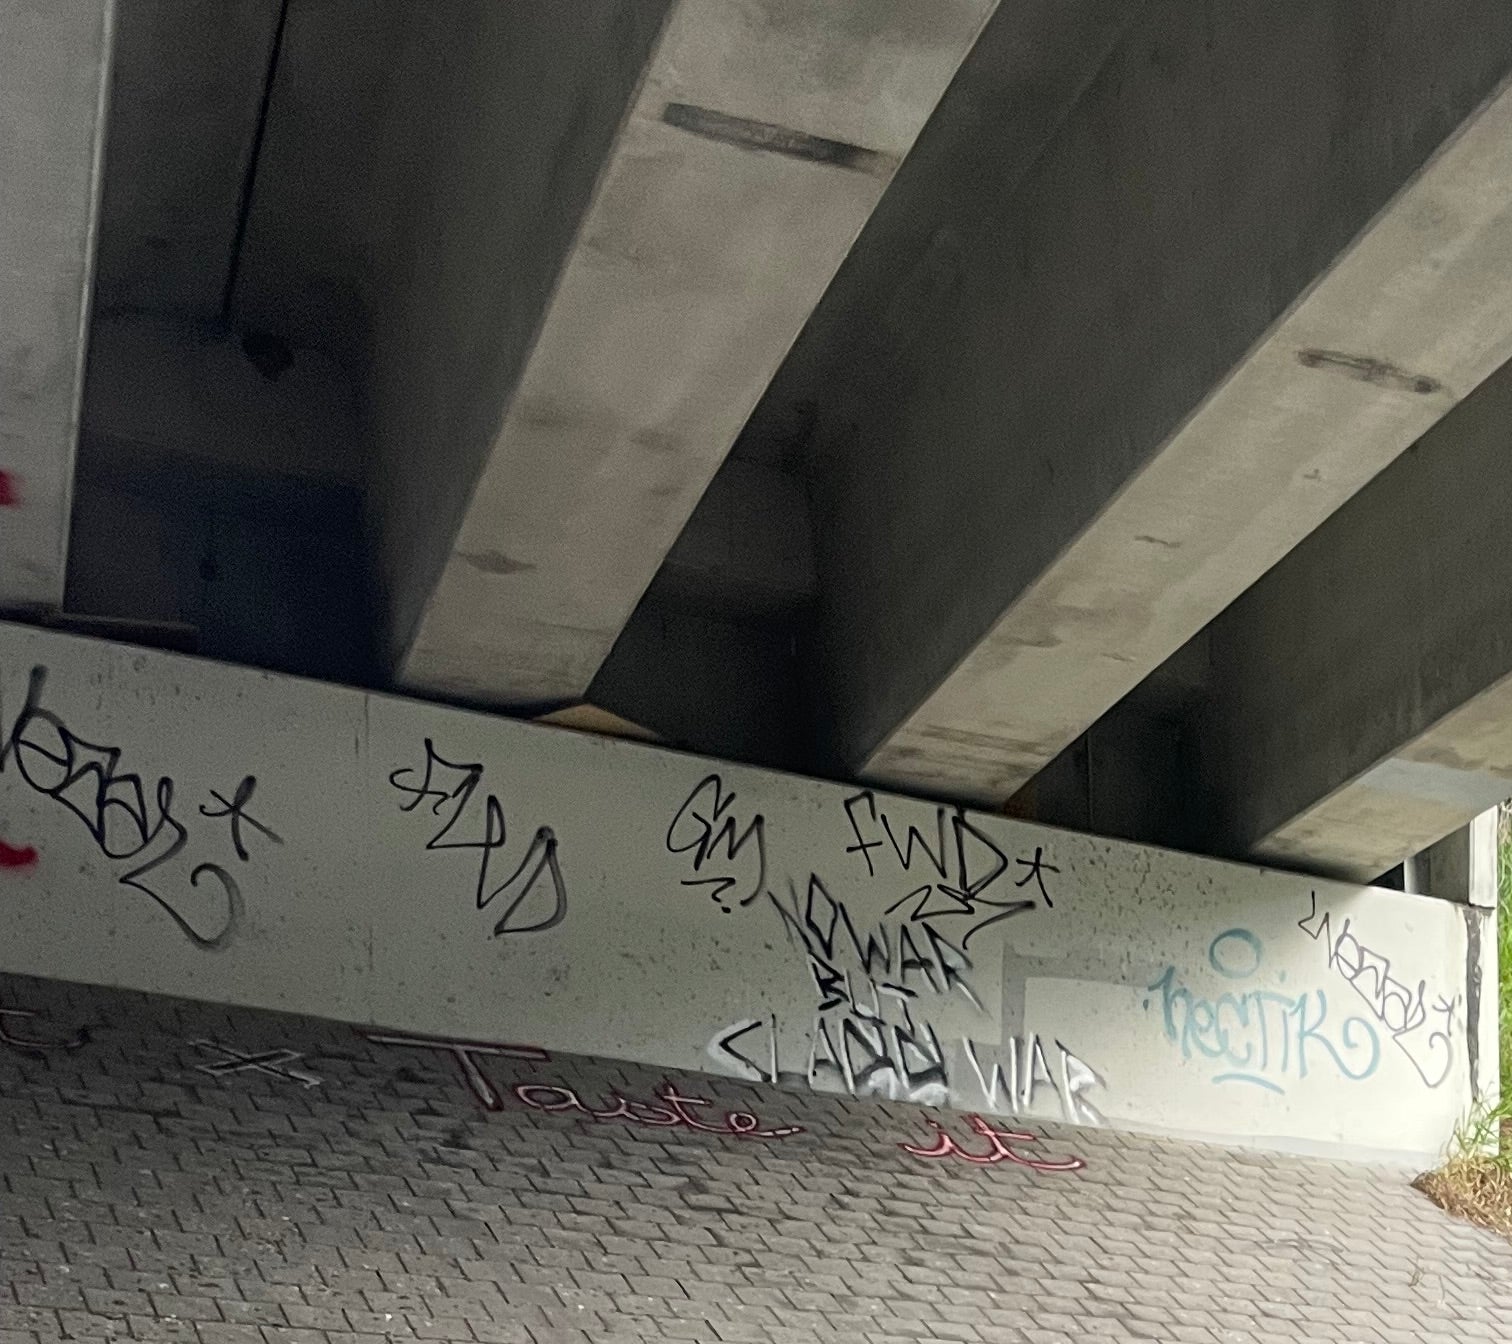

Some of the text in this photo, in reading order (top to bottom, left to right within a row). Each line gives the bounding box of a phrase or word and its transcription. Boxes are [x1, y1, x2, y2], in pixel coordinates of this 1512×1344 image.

[352, 1026, 802, 1137] Taste
[896, 1113, 1088, 1173] it
[961, 1030, 1108, 1126] WAR
